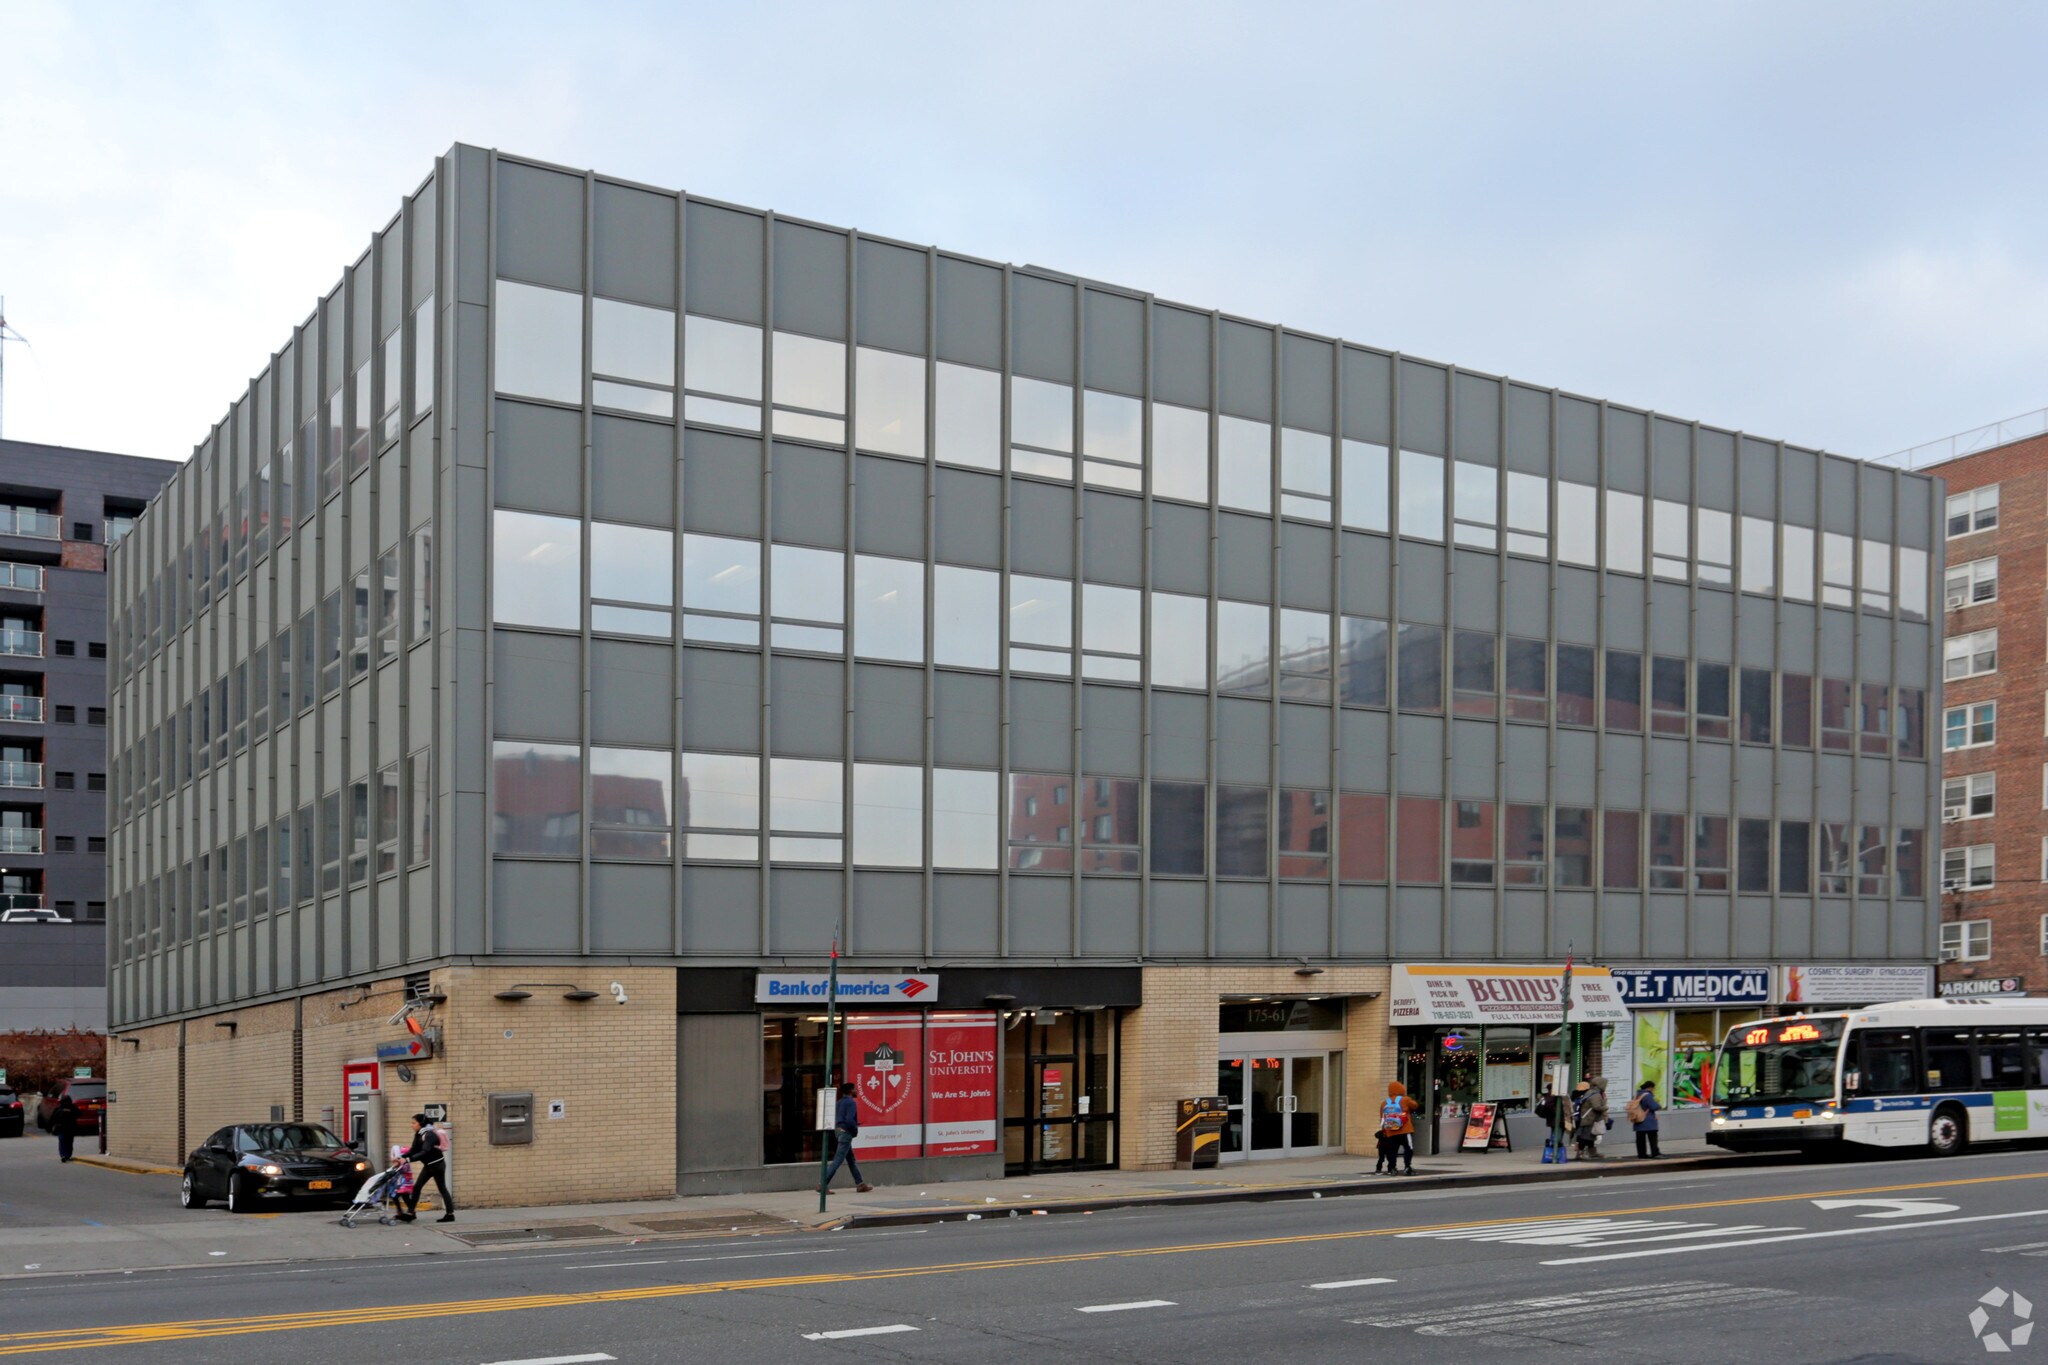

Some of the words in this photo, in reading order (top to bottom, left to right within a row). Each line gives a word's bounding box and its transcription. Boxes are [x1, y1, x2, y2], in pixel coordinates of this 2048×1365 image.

[1808, 968, 1841, 976] COSMETIC
[1844, 968, 1874, 976] SURGERY
[1880, 968, 1928, 976] GYNECOLOGIST
[768, 980, 811, 996] Bank
[810, 980, 829, 996] of
[833, 980, 890, 996] America
[1426, 980, 1444, 988] DINE
[1445, 980, 1453, 988] IN
[1581, 983, 1602, 992] FREE
[1672, 974, 1767, 998] MEDICAL
[1429, 990, 1447, 998] PICK
[1449, 990, 1459, 998] UP
[1582, 994, 1611, 1003] DELIVERY
[1392, 1007, 1420, 1017] PIZZERIA
[1480, 1004, 1513, 1012] PIZZERIA
[1248, 1008, 1286, 1022] 175-61
[929, 1050, 946, 1064] ST.
[948, 1049, 994, 1066] JOHN'S
[929, 1065, 994, 1076] UNIVERSITY
[931, 1091, 944, 1099] We
[945, 1091, 957, 1099] Are
[958, 1090, 969, 1098] St.
[970, 1089, 991, 1099] John's
